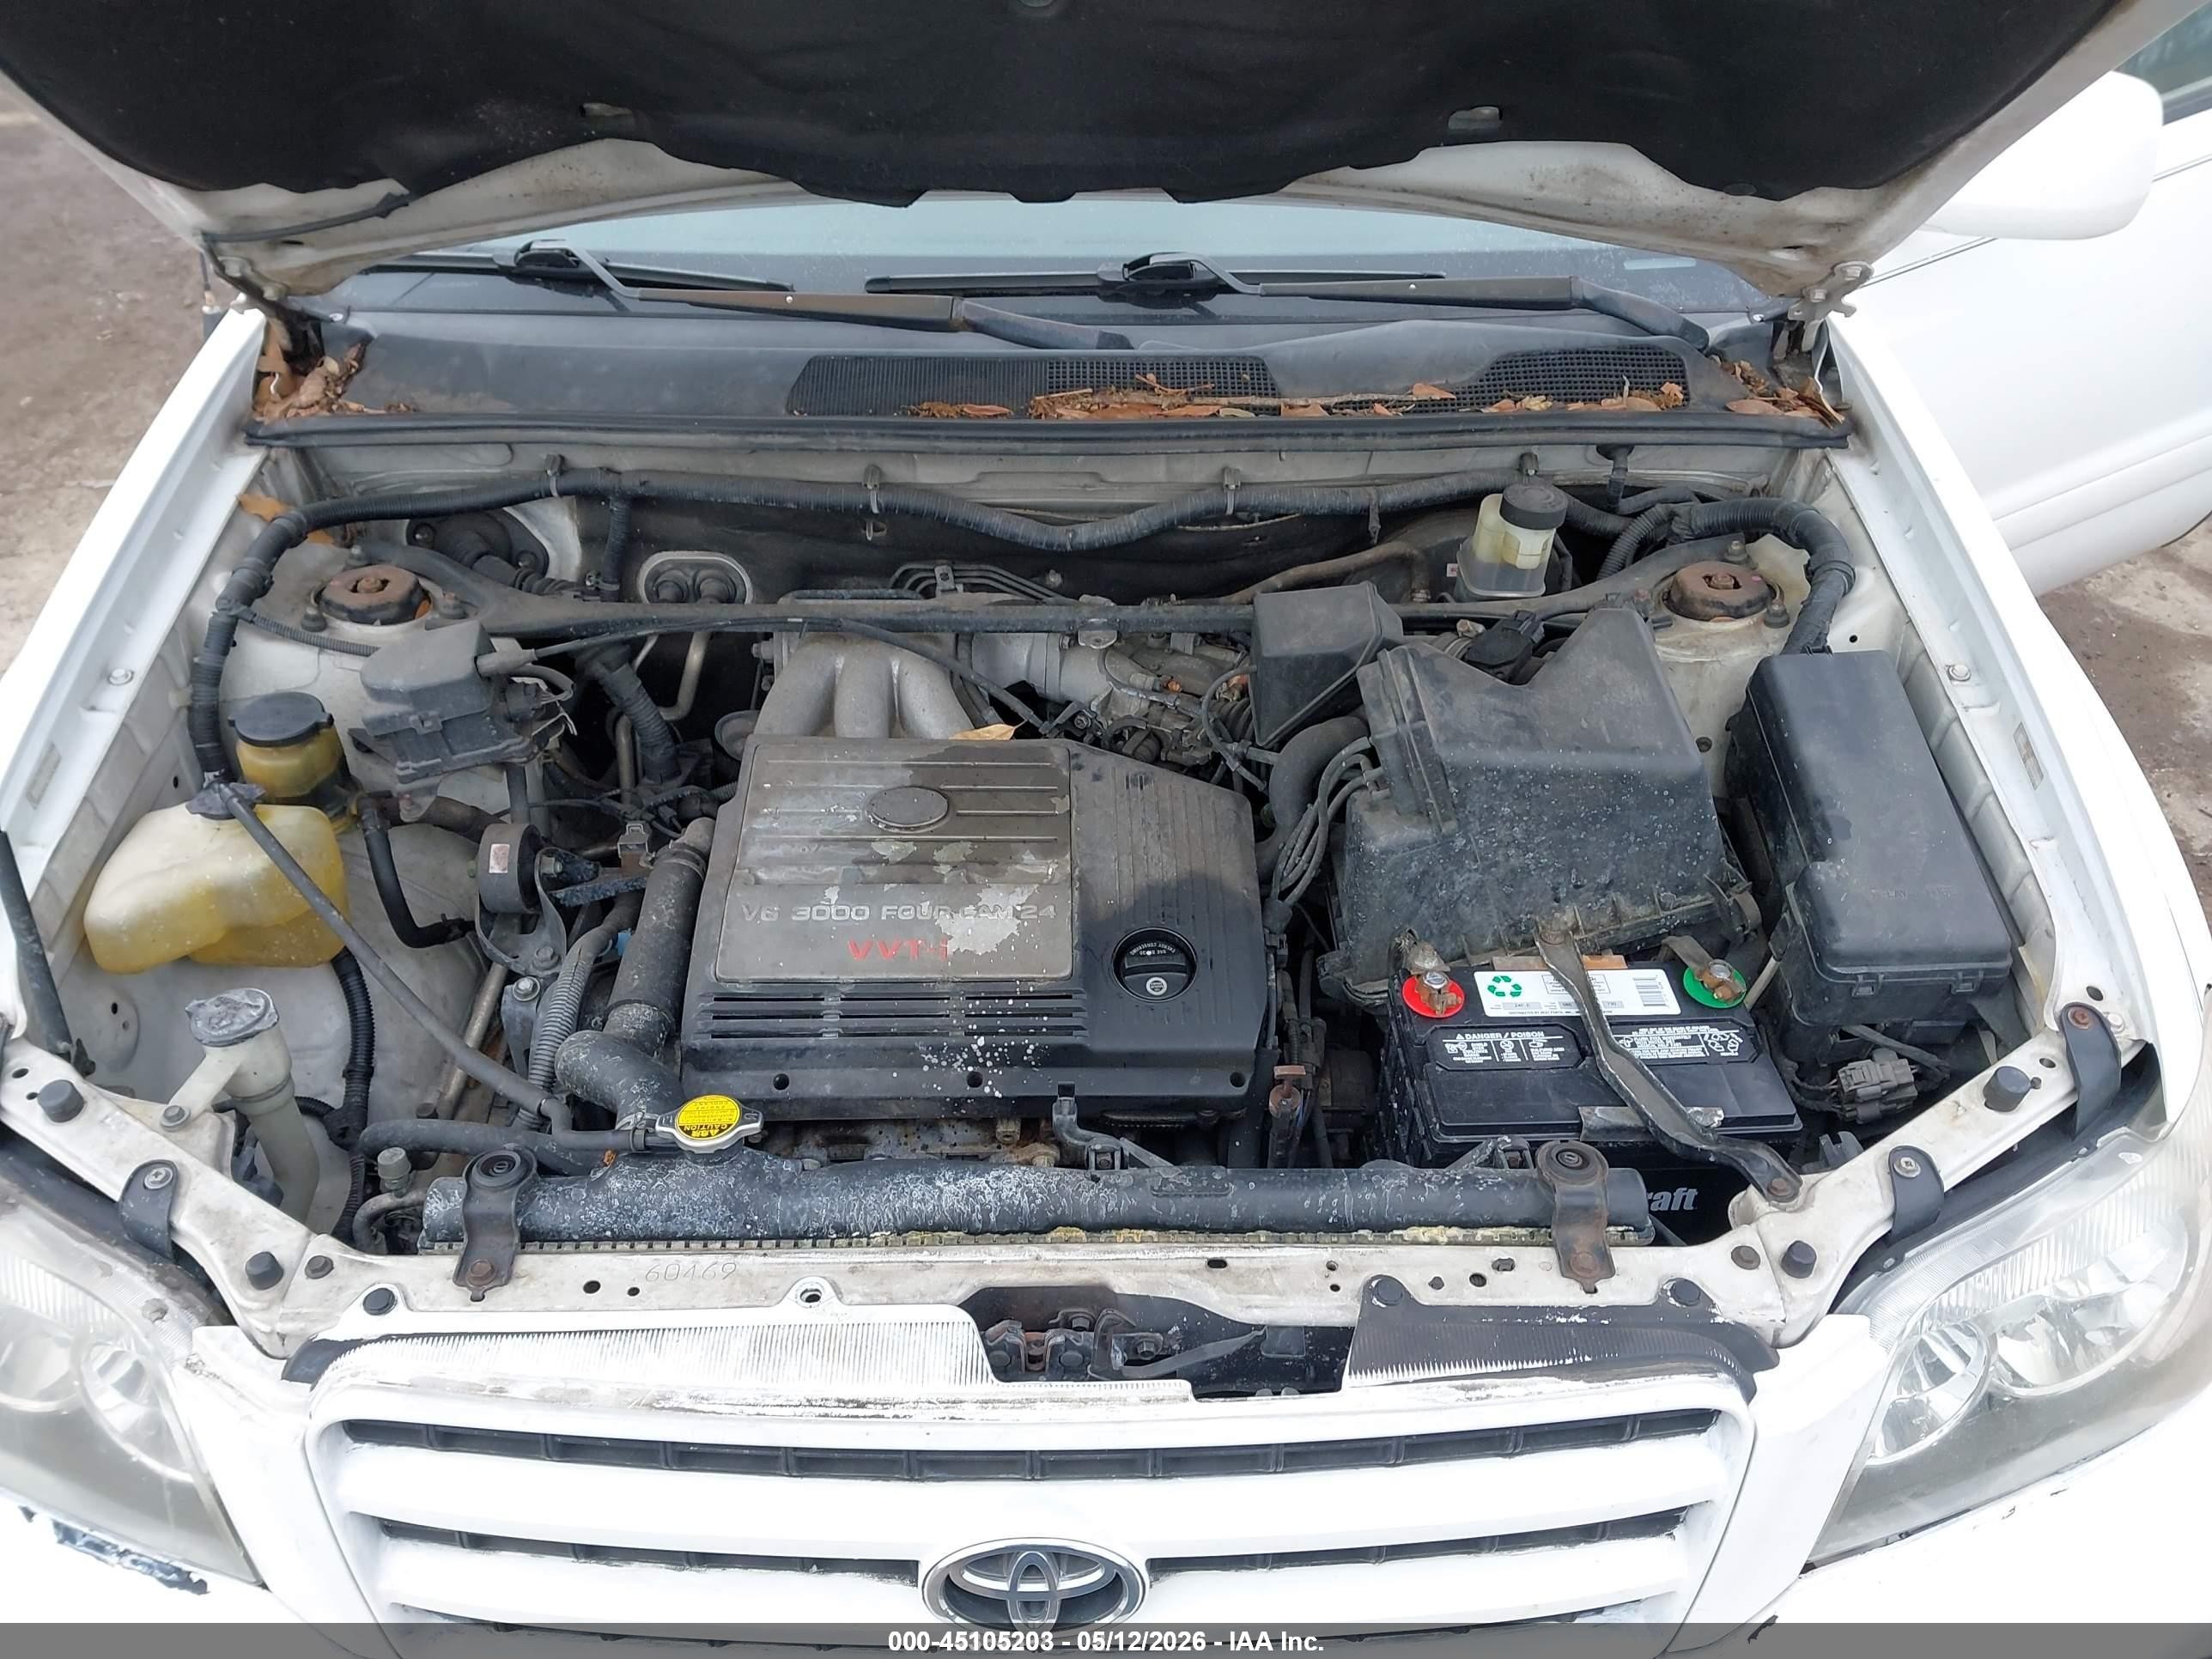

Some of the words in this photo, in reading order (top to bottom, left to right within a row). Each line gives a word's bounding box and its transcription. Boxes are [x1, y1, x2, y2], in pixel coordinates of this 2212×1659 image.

[741, 905, 781, 921] V6
[791, 905, 871, 921] 3000
[880, 905, 953, 921] FOUR
[1020, 904, 1058, 921] 24
